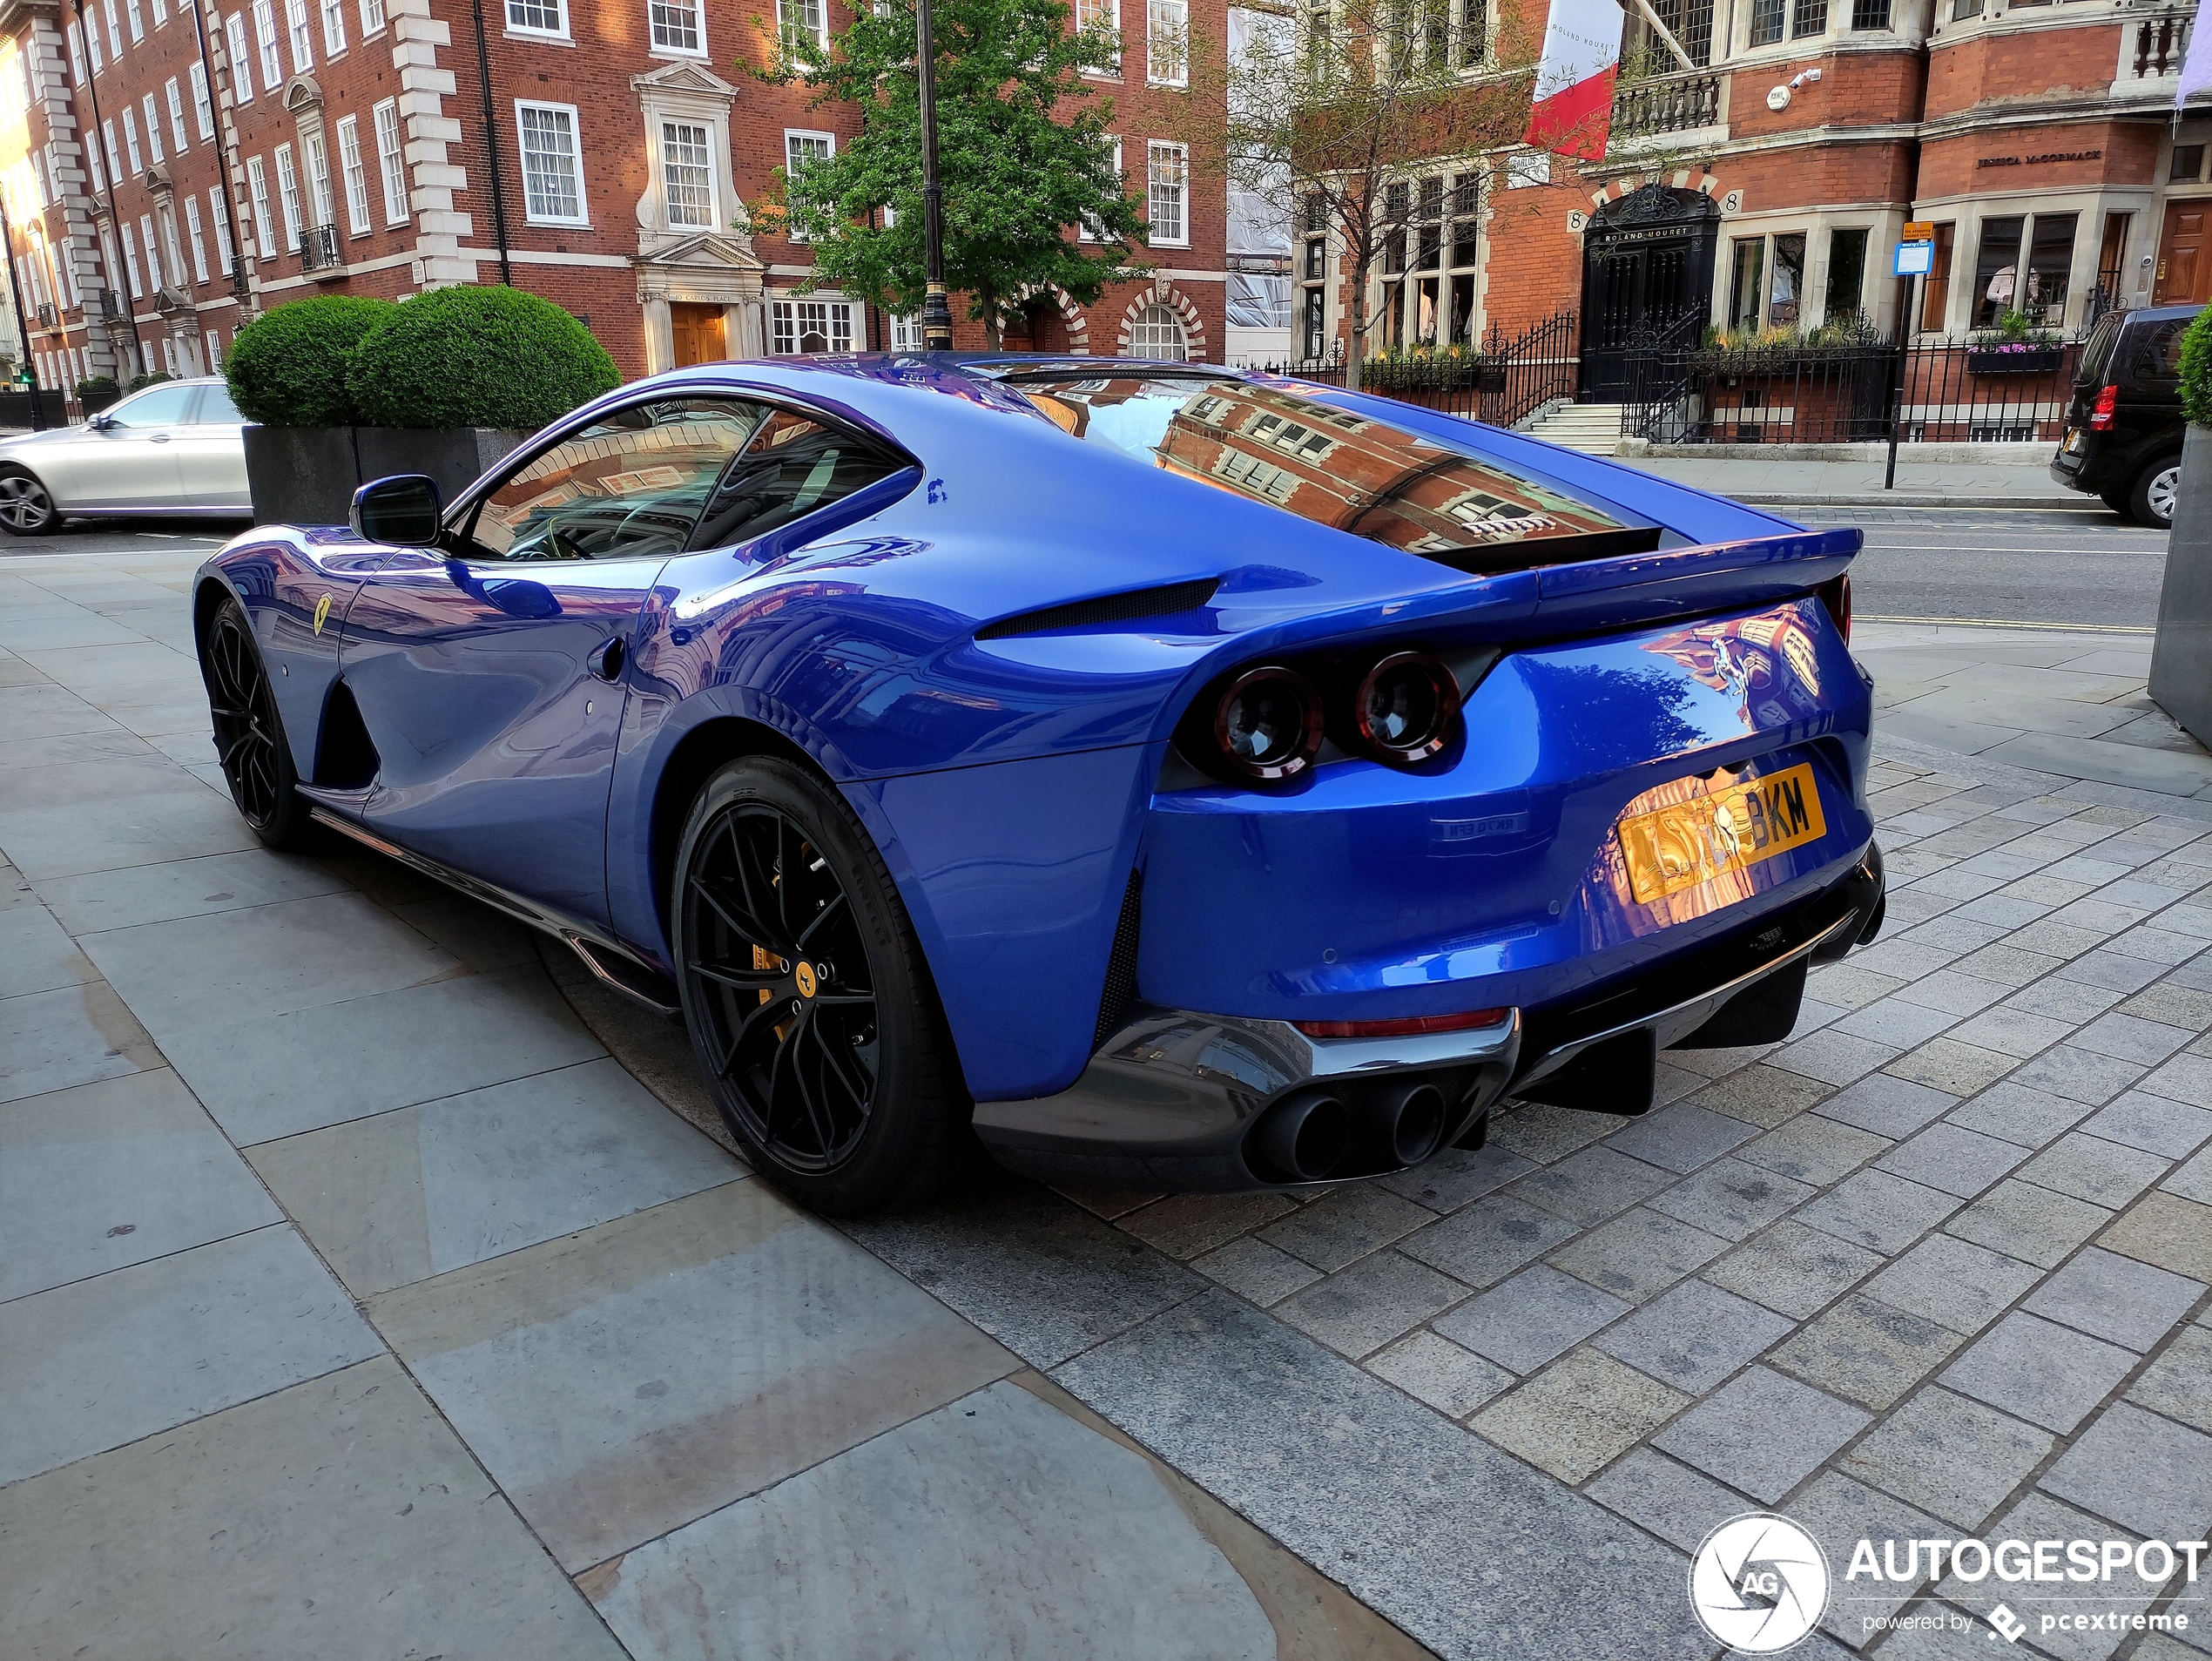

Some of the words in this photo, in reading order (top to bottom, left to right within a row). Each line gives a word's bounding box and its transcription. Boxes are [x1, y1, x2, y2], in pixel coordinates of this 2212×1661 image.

[1584, 37, 1615, 51] MOURET
[1725, 193, 1737, 212] 8
[1570, 213, 1581, 228] 8
[1605, 232, 1643, 242] ROLAND
[1648, 227, 1688, 238] MOURET
[1461, 517, 1557, 537] Ferrari
[1747, 776, 1810, 850] BKM
